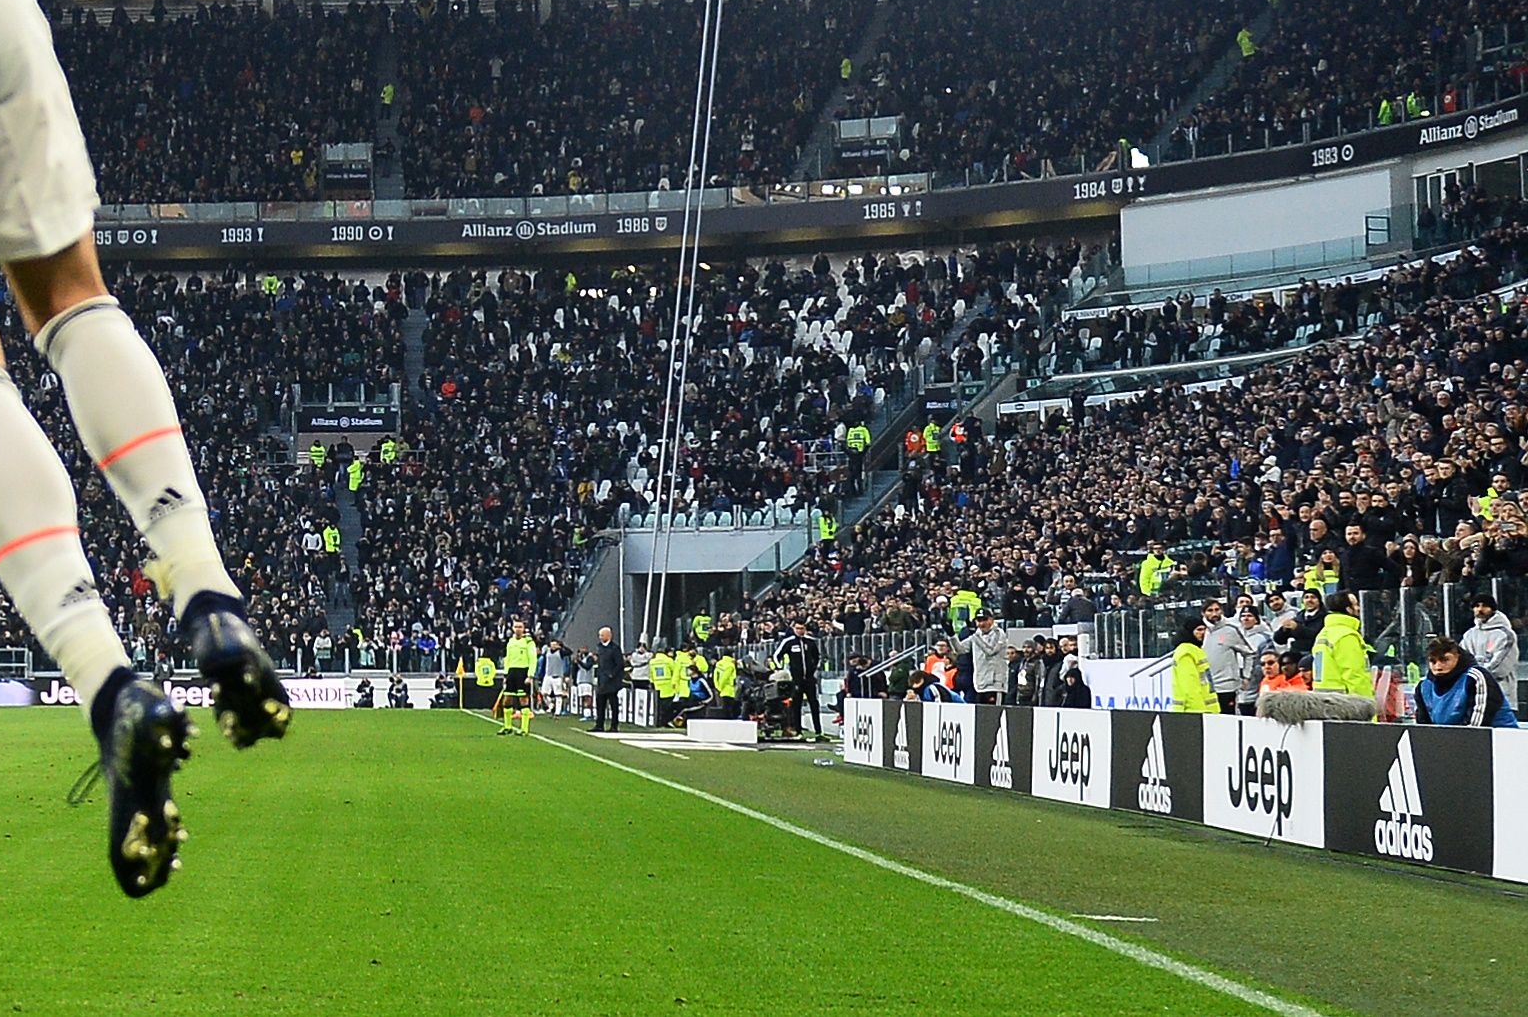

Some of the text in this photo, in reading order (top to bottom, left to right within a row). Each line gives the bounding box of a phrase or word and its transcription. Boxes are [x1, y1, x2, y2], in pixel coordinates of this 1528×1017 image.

[1419, 108, 1518, 145] Allianz Stadium
[1311, 146, 1339, 167] 1983
[1073, 180, 1107, 200] 1984
[863, 202, 896, 219] 1985
[221, 227, 253, 243] 1993
[331, 225, 364, 241] 1990
[461, 220, 597, 237] Allianz Stadium
[616, 217, 650, 233] 1986
[92, 230, 112, 245] 95
[311, 416, 383, 426] Allianz Stadium
[40, 680, 83, 705] Je
[286, 687, 342, 702] SARDI
[852, 700, 874, 763] Jeep
[933, 704, 963, 779] Jeep
[1048, 712, 1092, 802] Jeep
[1227, 720, 1293, 837] Jeep
[1138, 776, 1173, 815] adidas
[1374, 808, 1435, 863] adidas
